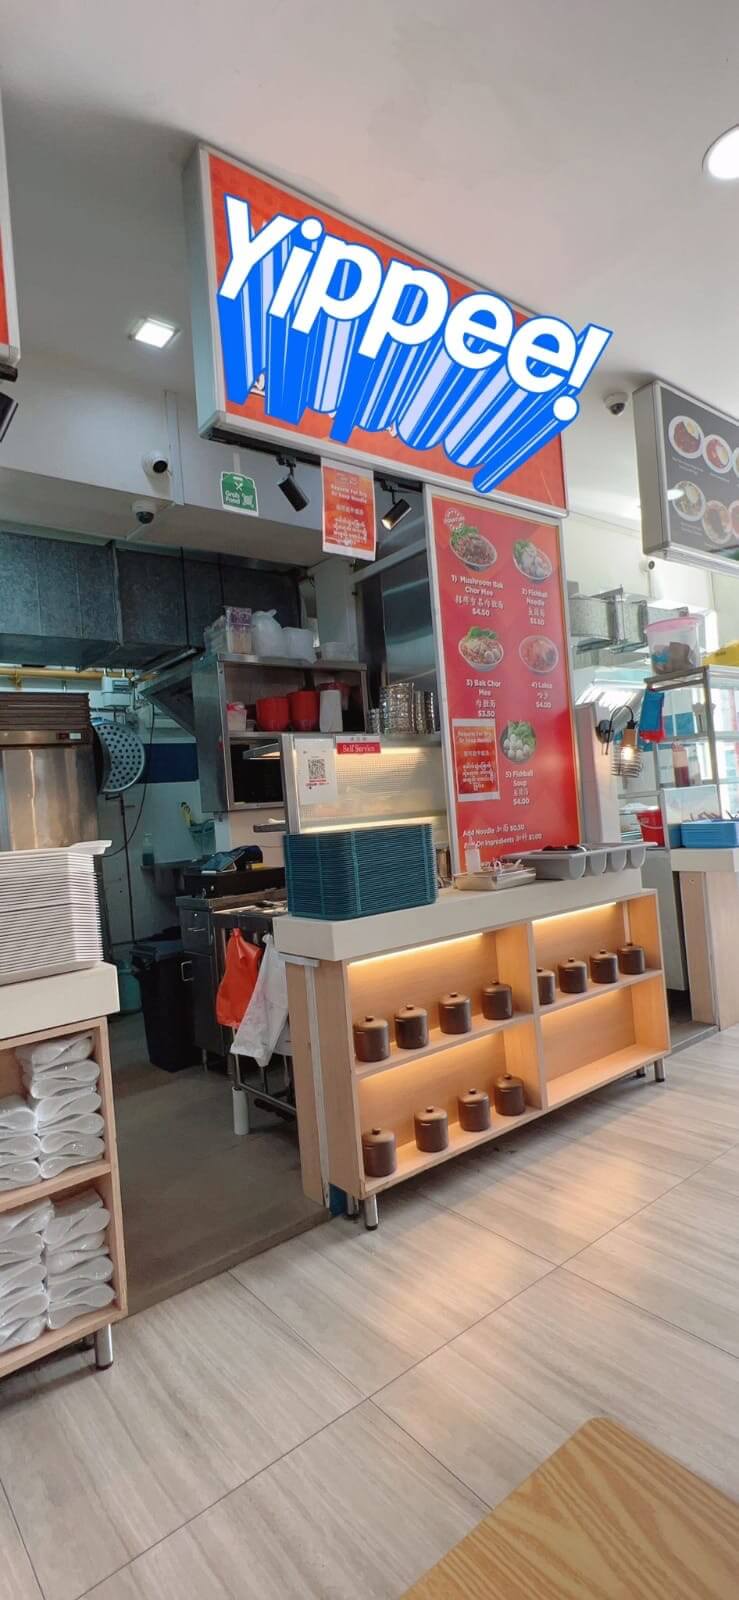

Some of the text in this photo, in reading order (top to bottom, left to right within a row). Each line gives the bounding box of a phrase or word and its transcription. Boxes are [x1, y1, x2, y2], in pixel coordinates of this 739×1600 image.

[225, 490, 240, 499] Grab
[226, 496, 240, 504] Food
[460, 576, 492, 587] Mushroom
[465, 586, 494, 597] Chor Mee
[472, 607, 490, 616] $4.50
[474, 679, 487, 687] Bak
[487, 679, 502, 689] Chor
[478, 688, 492, 697] Mee
[478, 710, 496, 718] $3.50
[342, 744, 355, 753] Self
[505, 769, 534, 778] 5) Fishball
[513, 780, 528, 788] Soup
[513, 797, 530, 806] $4.00
[463, 829, 475, 838] Add
[475, 826, 495, 835] Noodle
[484, 836, 515, 847] Ingredients
